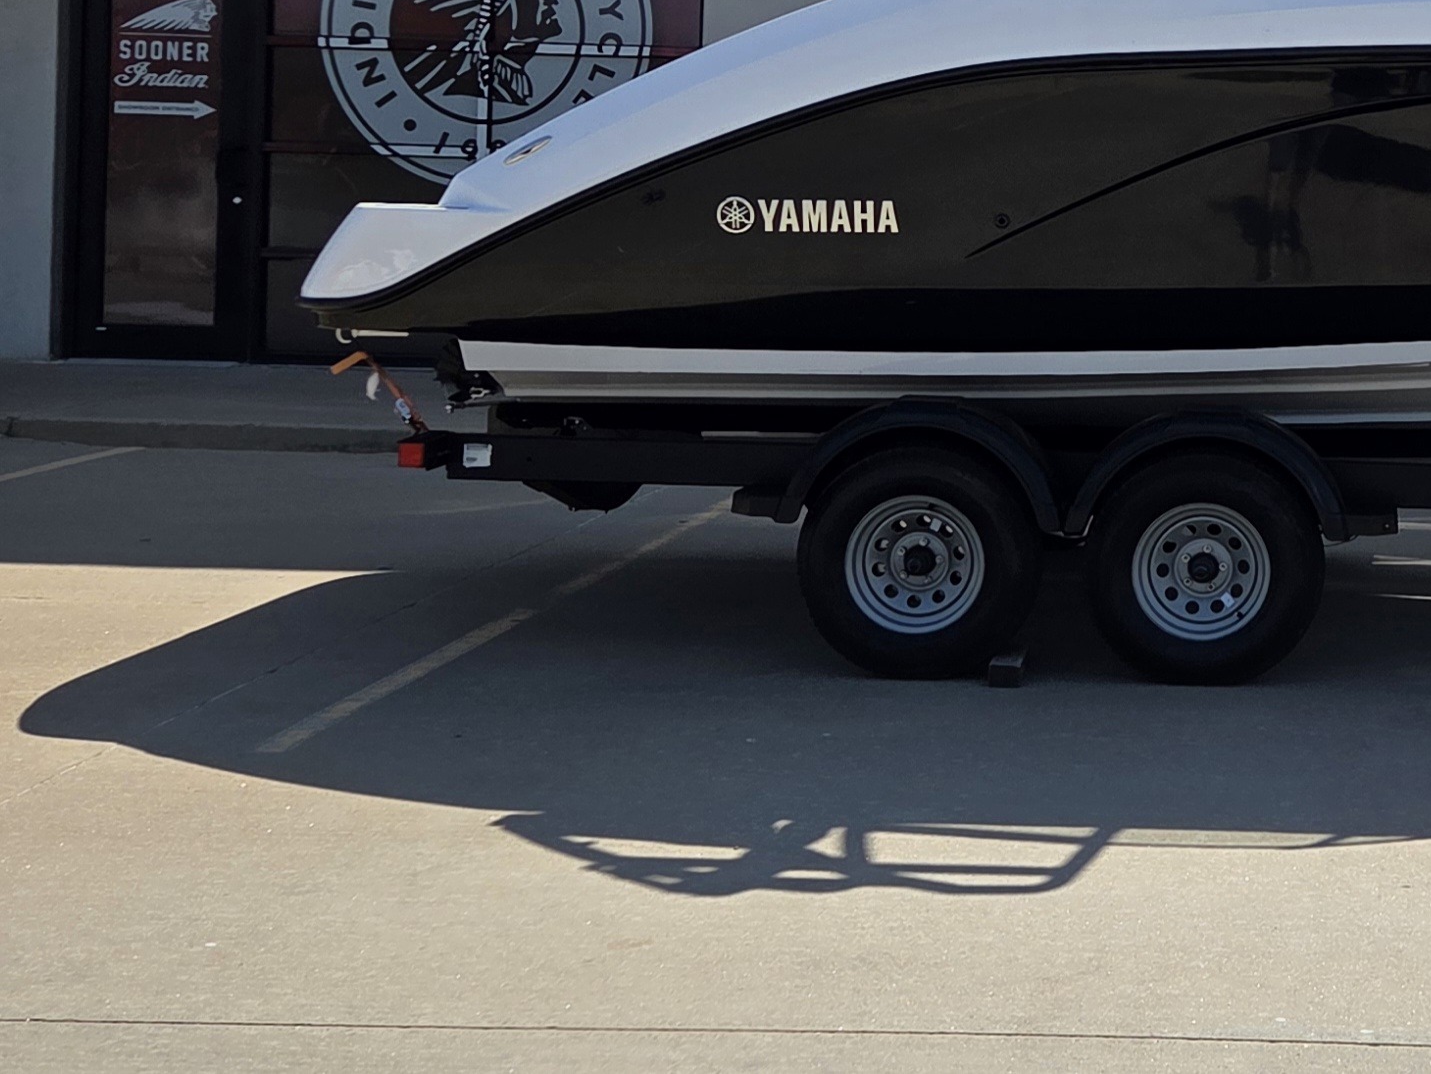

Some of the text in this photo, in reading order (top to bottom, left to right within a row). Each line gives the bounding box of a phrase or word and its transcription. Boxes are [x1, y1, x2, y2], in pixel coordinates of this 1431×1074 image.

[118, 39, 210, 62] SOONER
[113, 61, 210, 89] Indian
[757, 199, 899, 233] YAMAHA
